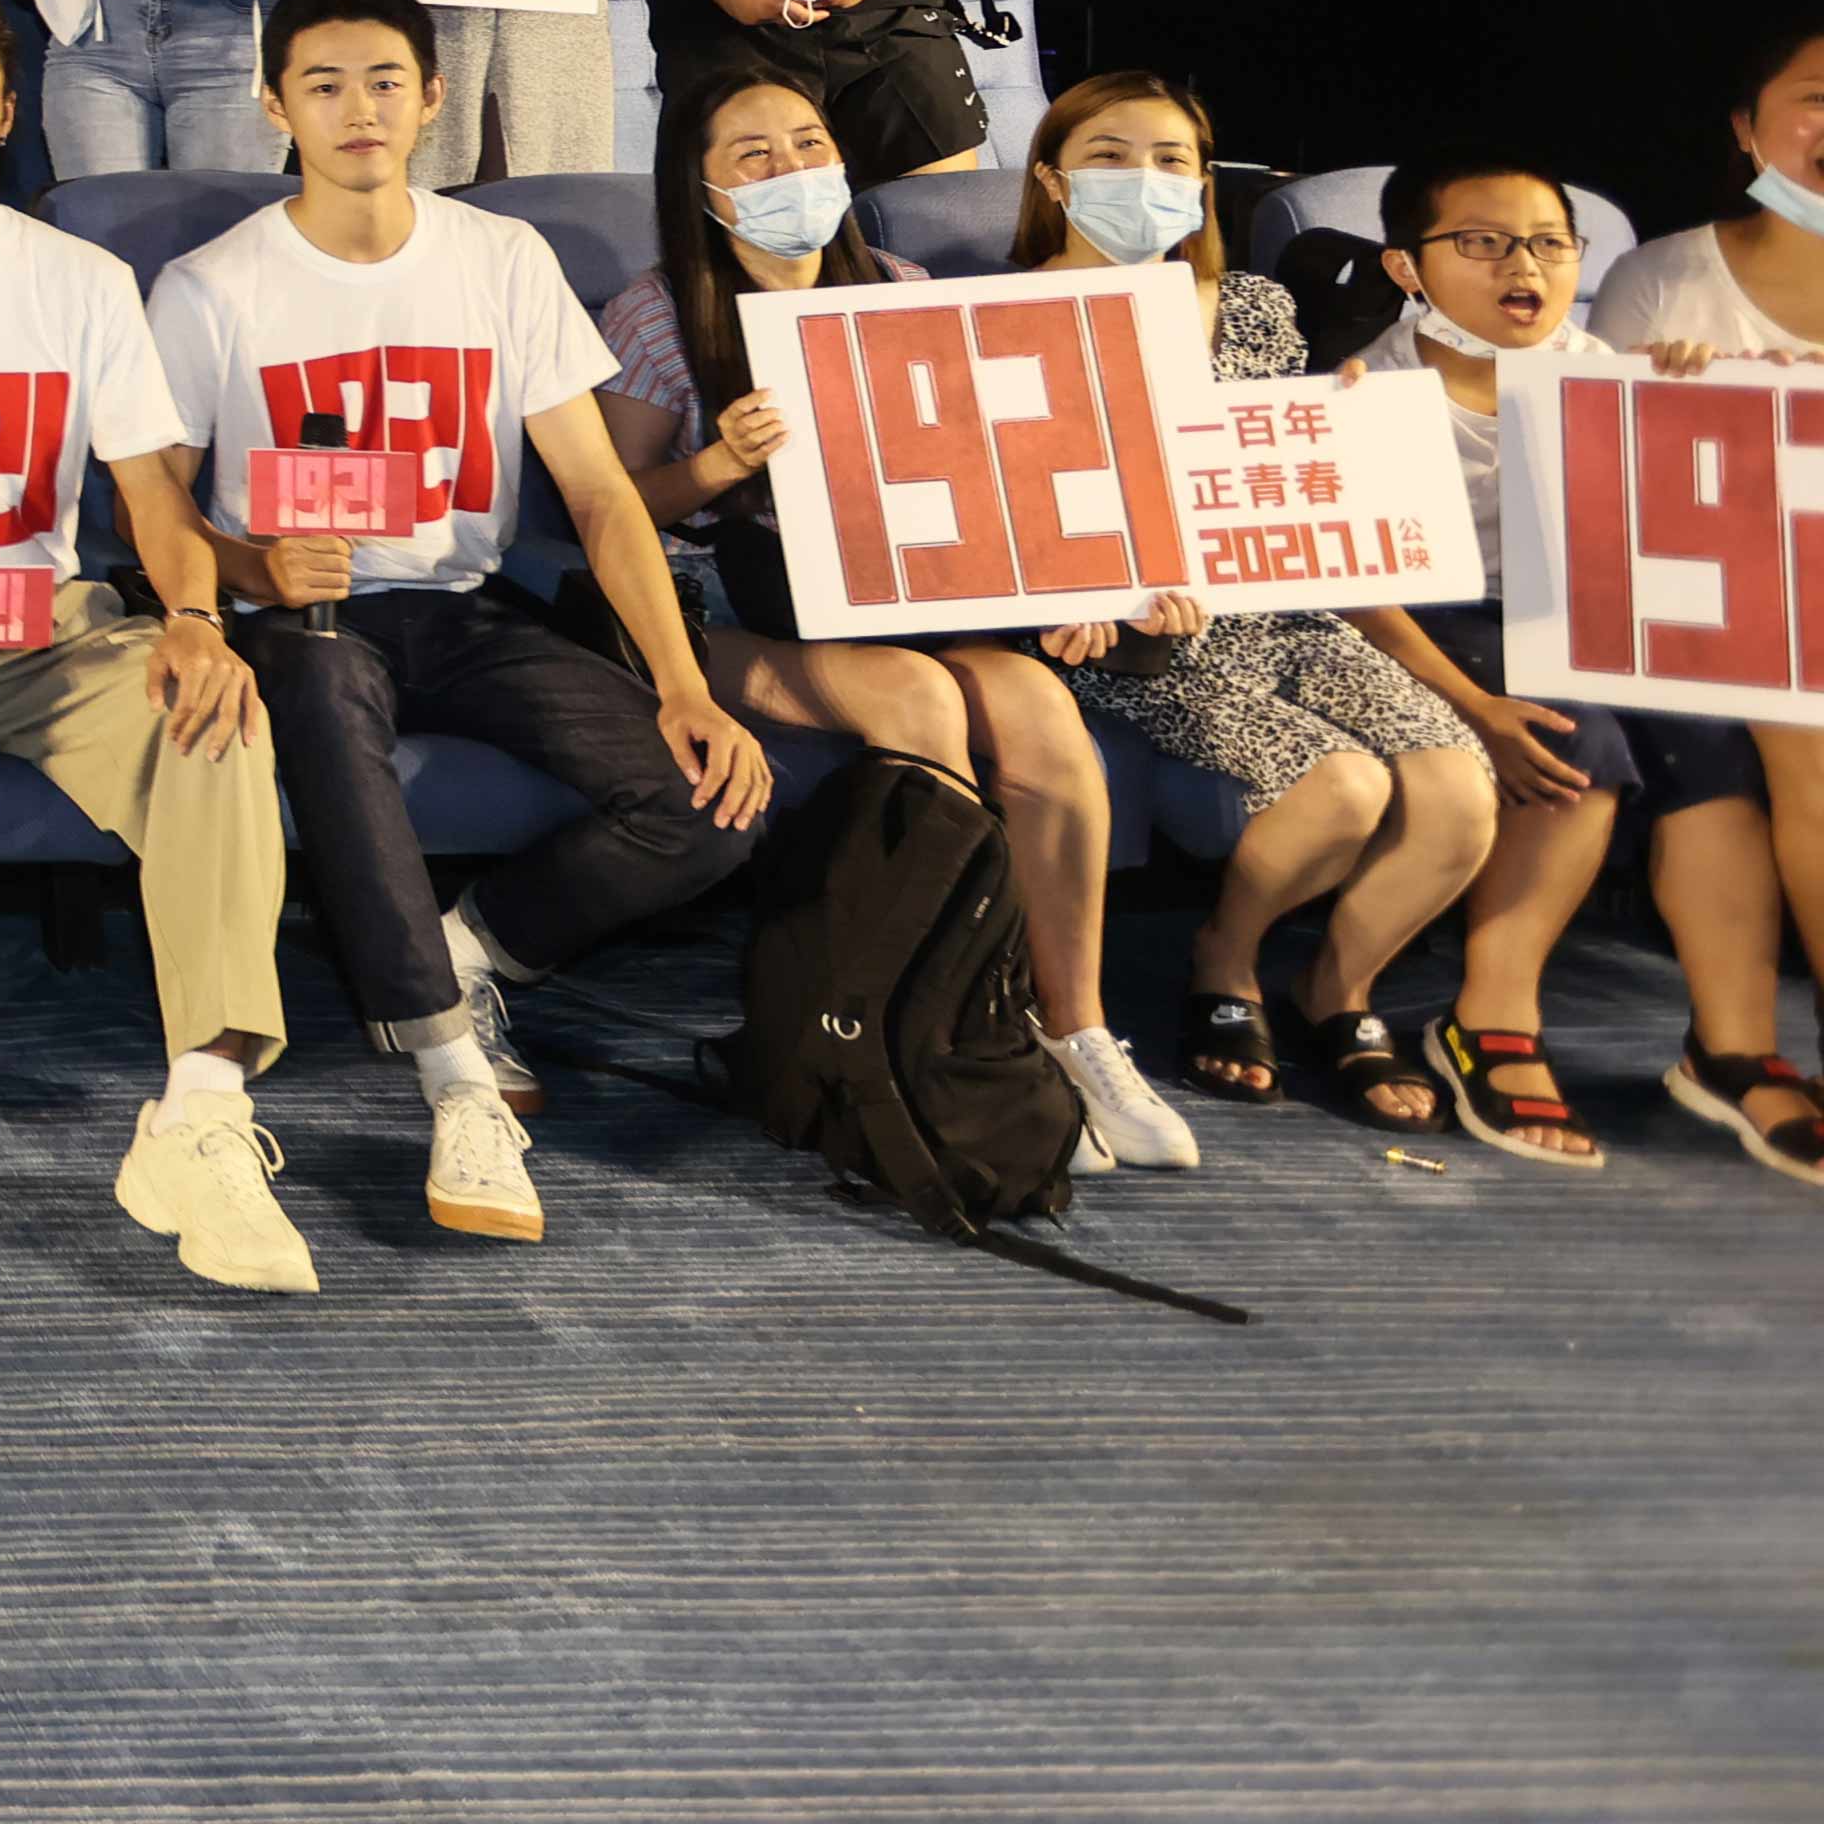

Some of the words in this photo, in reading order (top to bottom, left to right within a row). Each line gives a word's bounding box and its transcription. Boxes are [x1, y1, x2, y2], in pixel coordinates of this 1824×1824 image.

[797, 292, 1190, 605] 1921
[1176, 401, 1332, 449] 一百年
[275, 455, 387, 531] 1921
[1186, 460, 1344, 512] 正青春
[1198, 518, 1399, 585] 2021.7.1
[1560, 376, 1824, 692] 19
